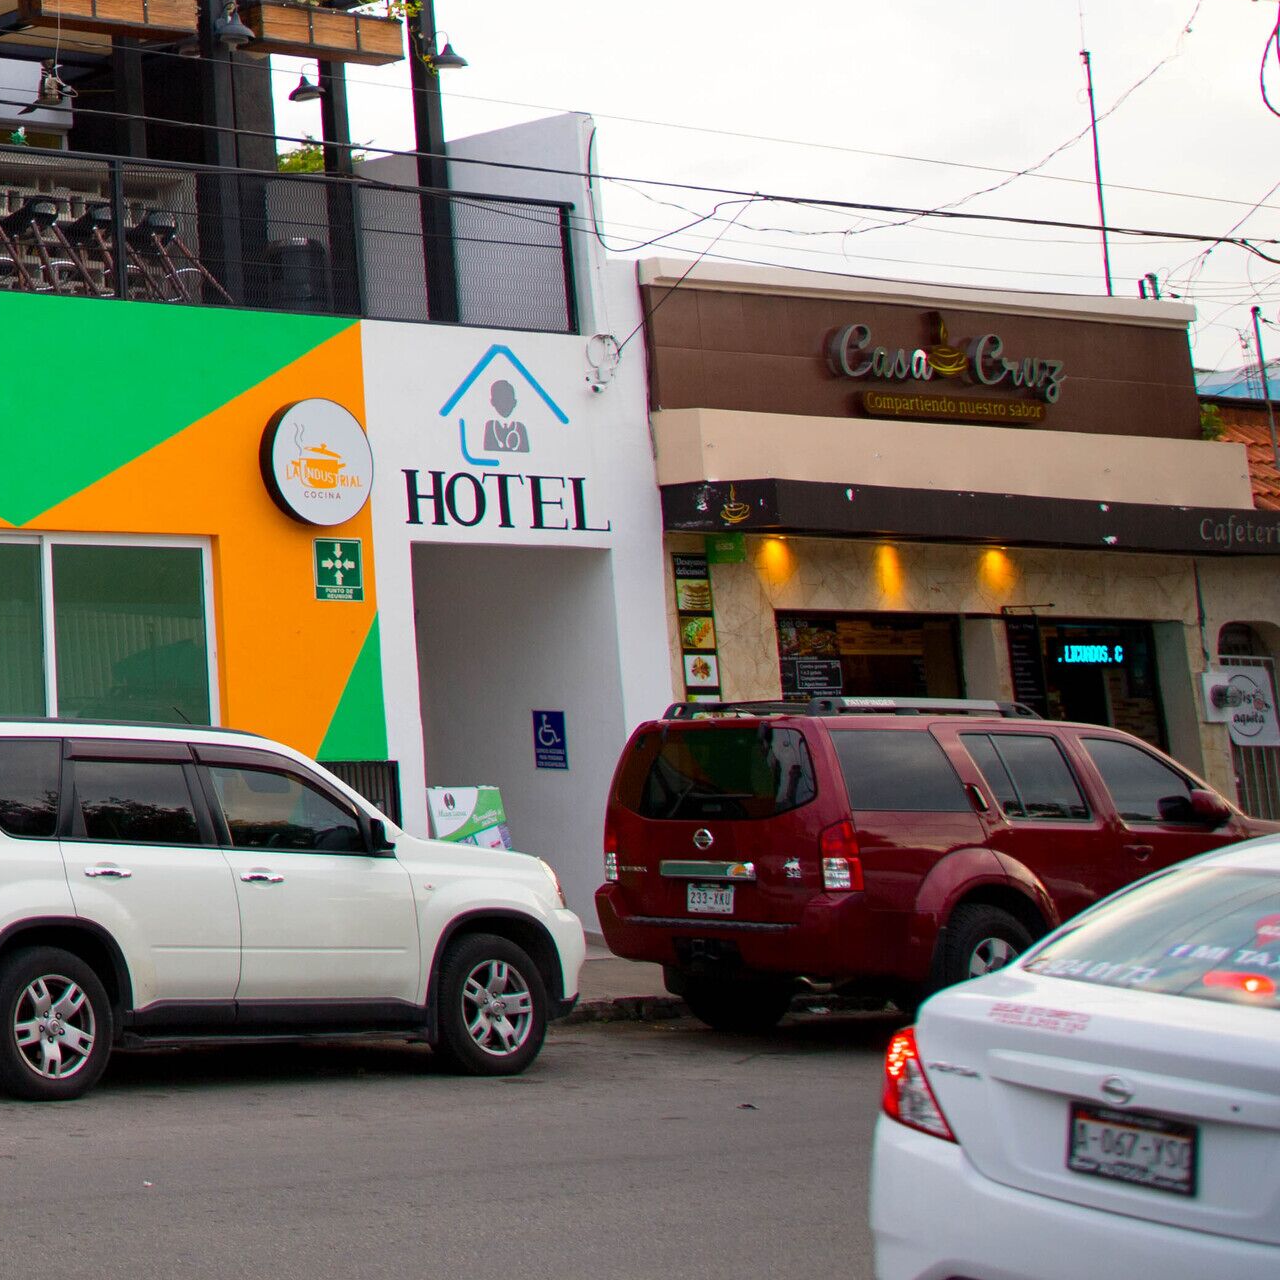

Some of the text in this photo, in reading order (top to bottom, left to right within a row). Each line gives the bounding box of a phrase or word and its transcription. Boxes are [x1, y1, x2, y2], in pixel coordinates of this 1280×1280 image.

[833, 322, 1069, 404] Casa Cruz
[866, 391, 1044, 418] Compartiendo nuestro sabor
[286, 464, 363, 488] LA INDUSTRIAL
[304, 490, 342, 500] COCINA
[401, 468, 612, 532] HOTEL
